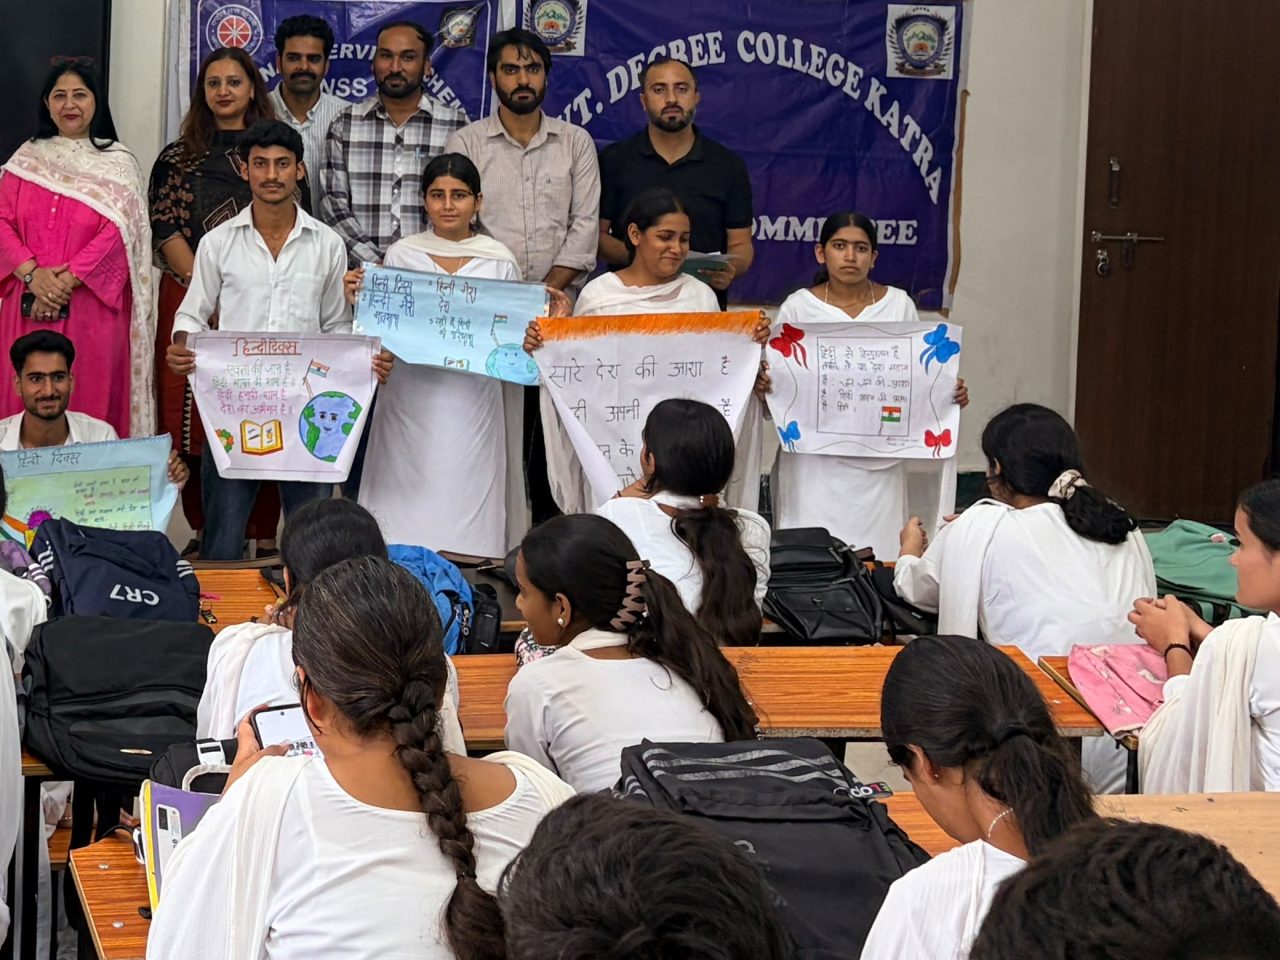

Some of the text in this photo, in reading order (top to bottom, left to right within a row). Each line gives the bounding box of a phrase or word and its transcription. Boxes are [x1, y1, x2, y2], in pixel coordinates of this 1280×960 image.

[320, 78, 368, 97] NSS
[736, 30, 864, 100] COLLEGE
[864, 77, 942, 205] KATRA
[231, 337, 300, 357] हिन्दी दिवस
[549, 357, 585, 388] सारे
[635, 354, 658, 380] की
[720, 355, 730, 375] है
[605, 398, 640, 422] अपनी
[619, 438, 635, 457] के
[109, 584, 160, 606] CR7
